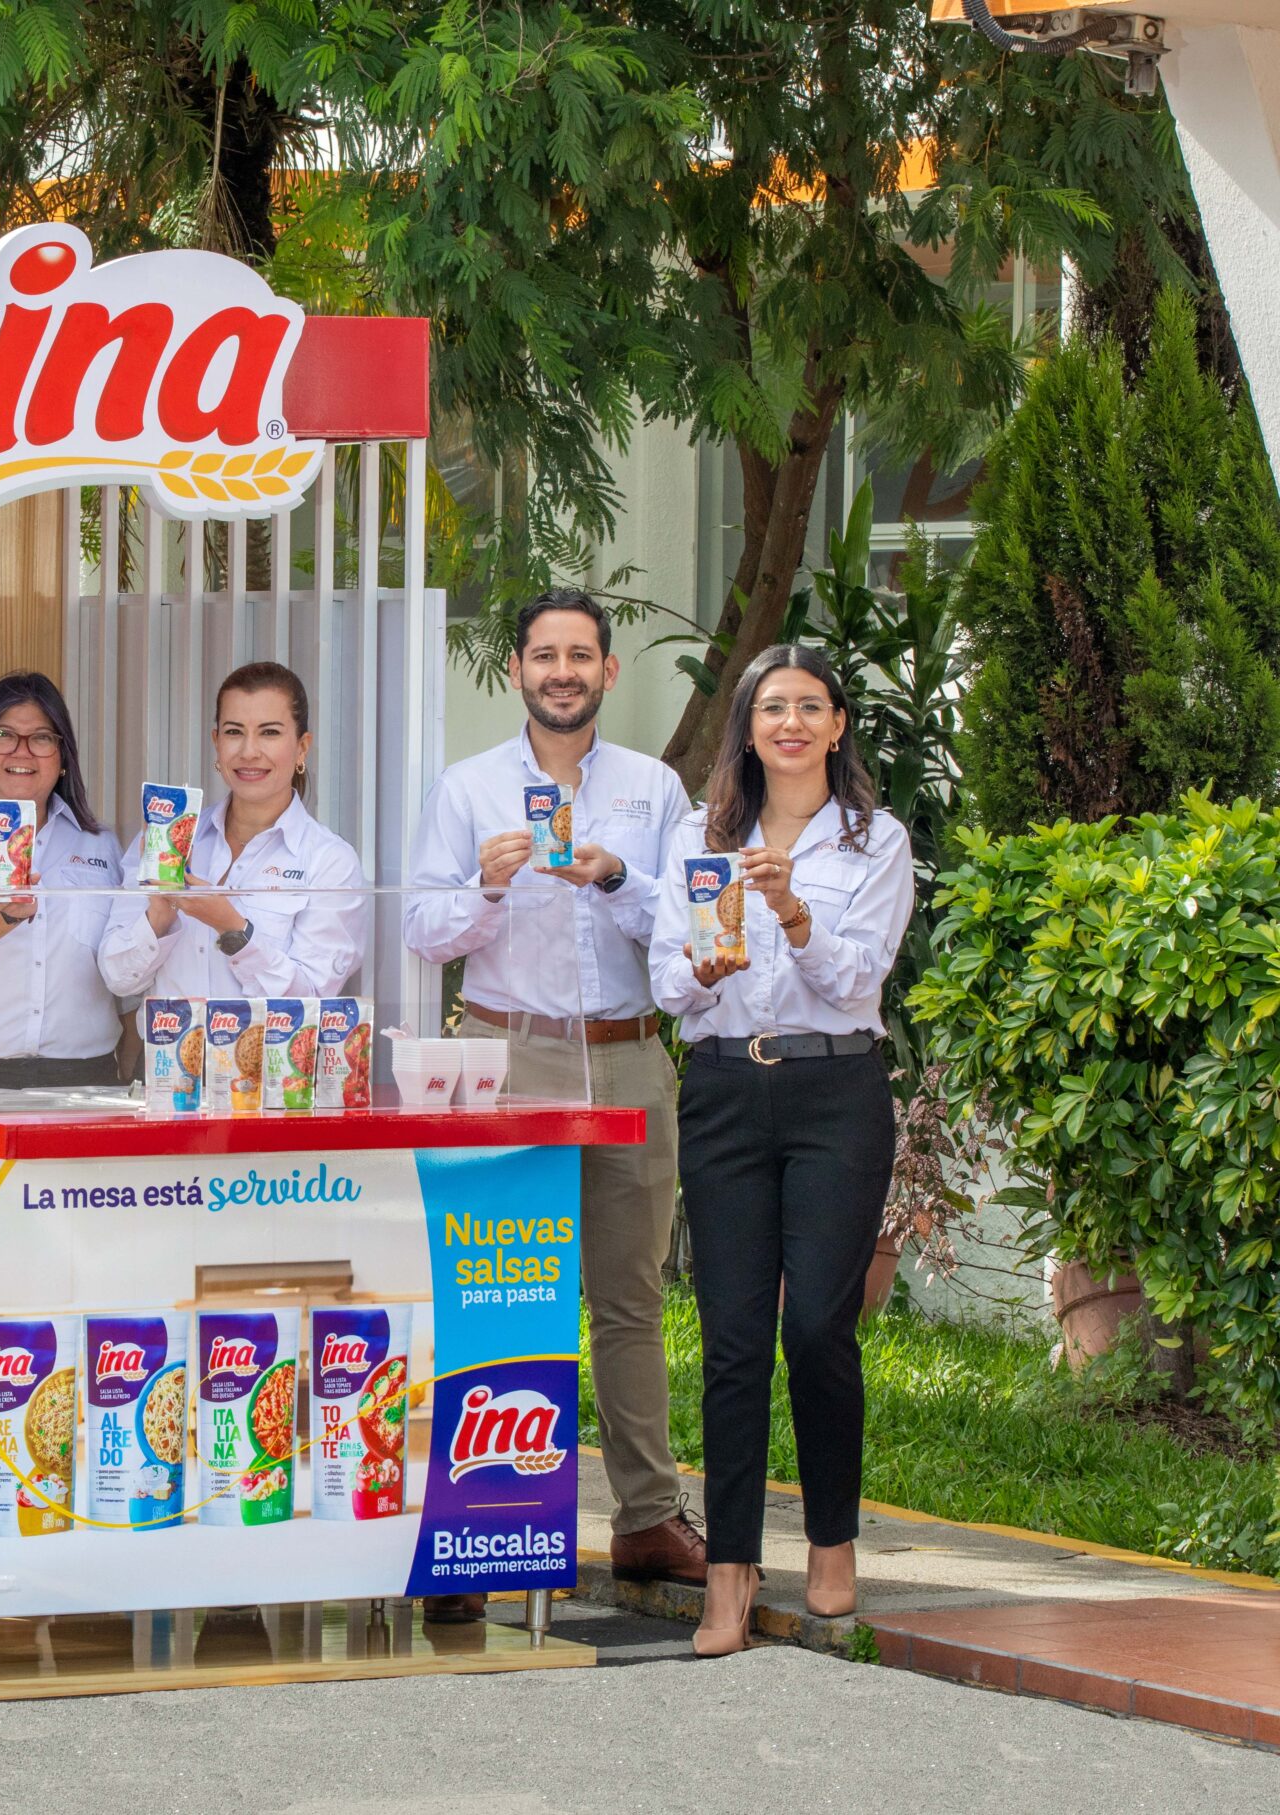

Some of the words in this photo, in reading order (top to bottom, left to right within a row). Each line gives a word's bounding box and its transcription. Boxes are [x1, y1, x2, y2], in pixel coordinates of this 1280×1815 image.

[148, 797, 174, 813] ina
[530, 796, 551, 809] ina
[692, 870, 718, 888] ina
[152, 1012, 179, 1028] ina
[211, 1012, 238, 1029] ina
[266, 1012, 291, 1028] ina
[322, 1012, 346, 1028] ina
[323, 1048, 336, 1056] TO
[325, 1056, 342, 1066] MA
[155, 1068, 170, 1076] DO
[323, 1066, 334, 1075] TE
[428, 1077, 446, 1089] ina
[476, 1078, 494, 1090] ina
[23, 1184, 56, 1210] La
[62, 1183, 137, 1208] mesa
[144, 1176, 204, 1206] está
[208, 1163, 362, 1212] servida
[444, 1212, 574, 1247] Nuevas
[455, 1248, 561, 1285] salsas
[461, 1289, 502, 1310] para
[506, 1285, 556, 1308] pasta
[96, 1343, 144, 1376] ina
[209, 1338, 256, 1371] ina
[321, 1335, 366, 1368] ina
[100, 1412, 122, 1430] AL
[214, 1408, 235, 1426] ITA
[321, 1406, 340, 1422] TO
[217, 1426, 242, 1442] LIA
[326, 1424, 350, 1440] MA
[454, 1390, 556, 1462] ina
[102, 1430, 132, 1448] FRE
[100, 1448, 123, 1466] DO
[214, 1443, 236, 1460] NA
[321, 1442, 338, 1459] TE
[434, 1524, 566, 1560] Búscalas
[432, 1562, 450, 1576] en
[452, 1555, 567, 1578] supermercados
